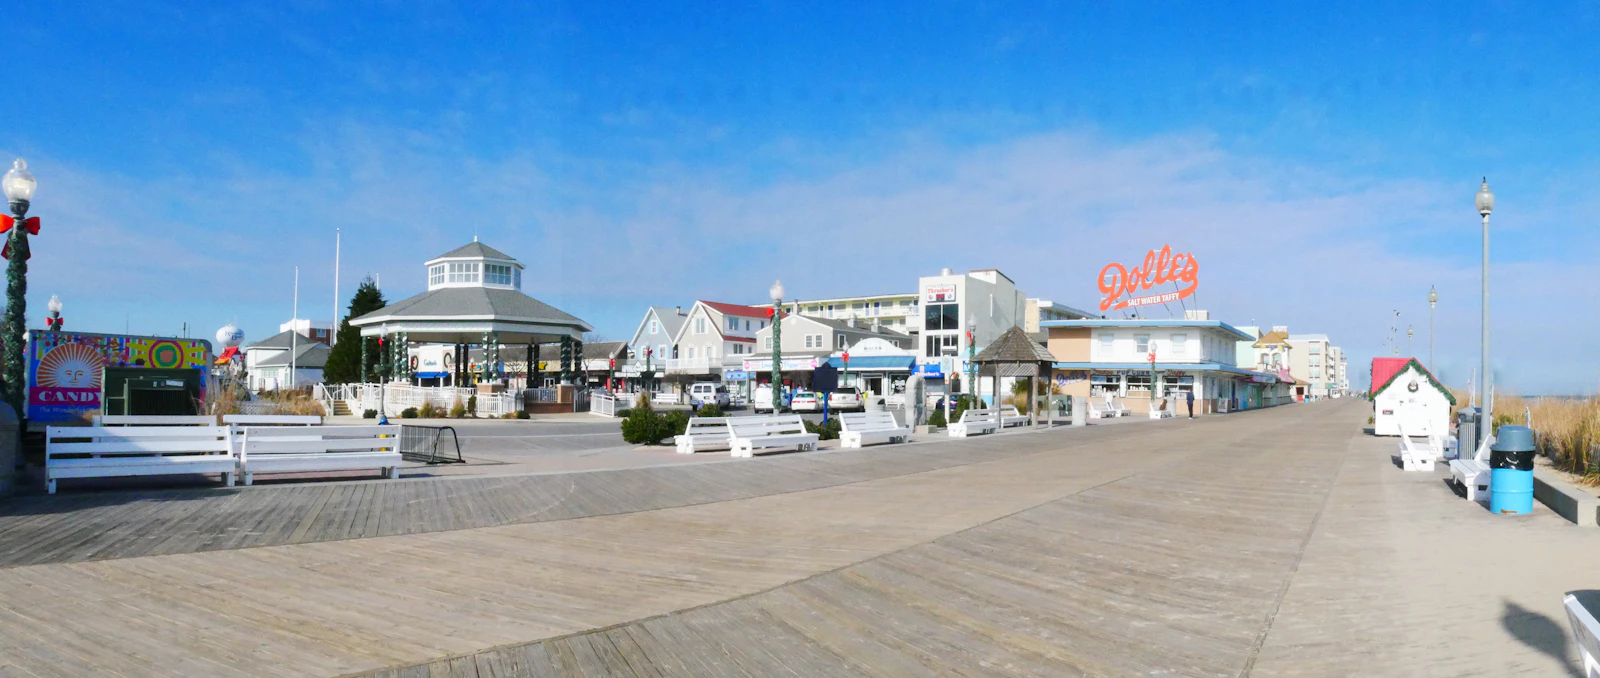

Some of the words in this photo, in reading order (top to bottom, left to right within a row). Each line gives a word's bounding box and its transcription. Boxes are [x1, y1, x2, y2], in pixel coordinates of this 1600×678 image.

[1127, 298, 1140, 307] SALT
[1141, 295, 1160, 305] WATER
[1161, 292, 1180, 302] TAFFY
[38, 390, 101, 402] CANDY
